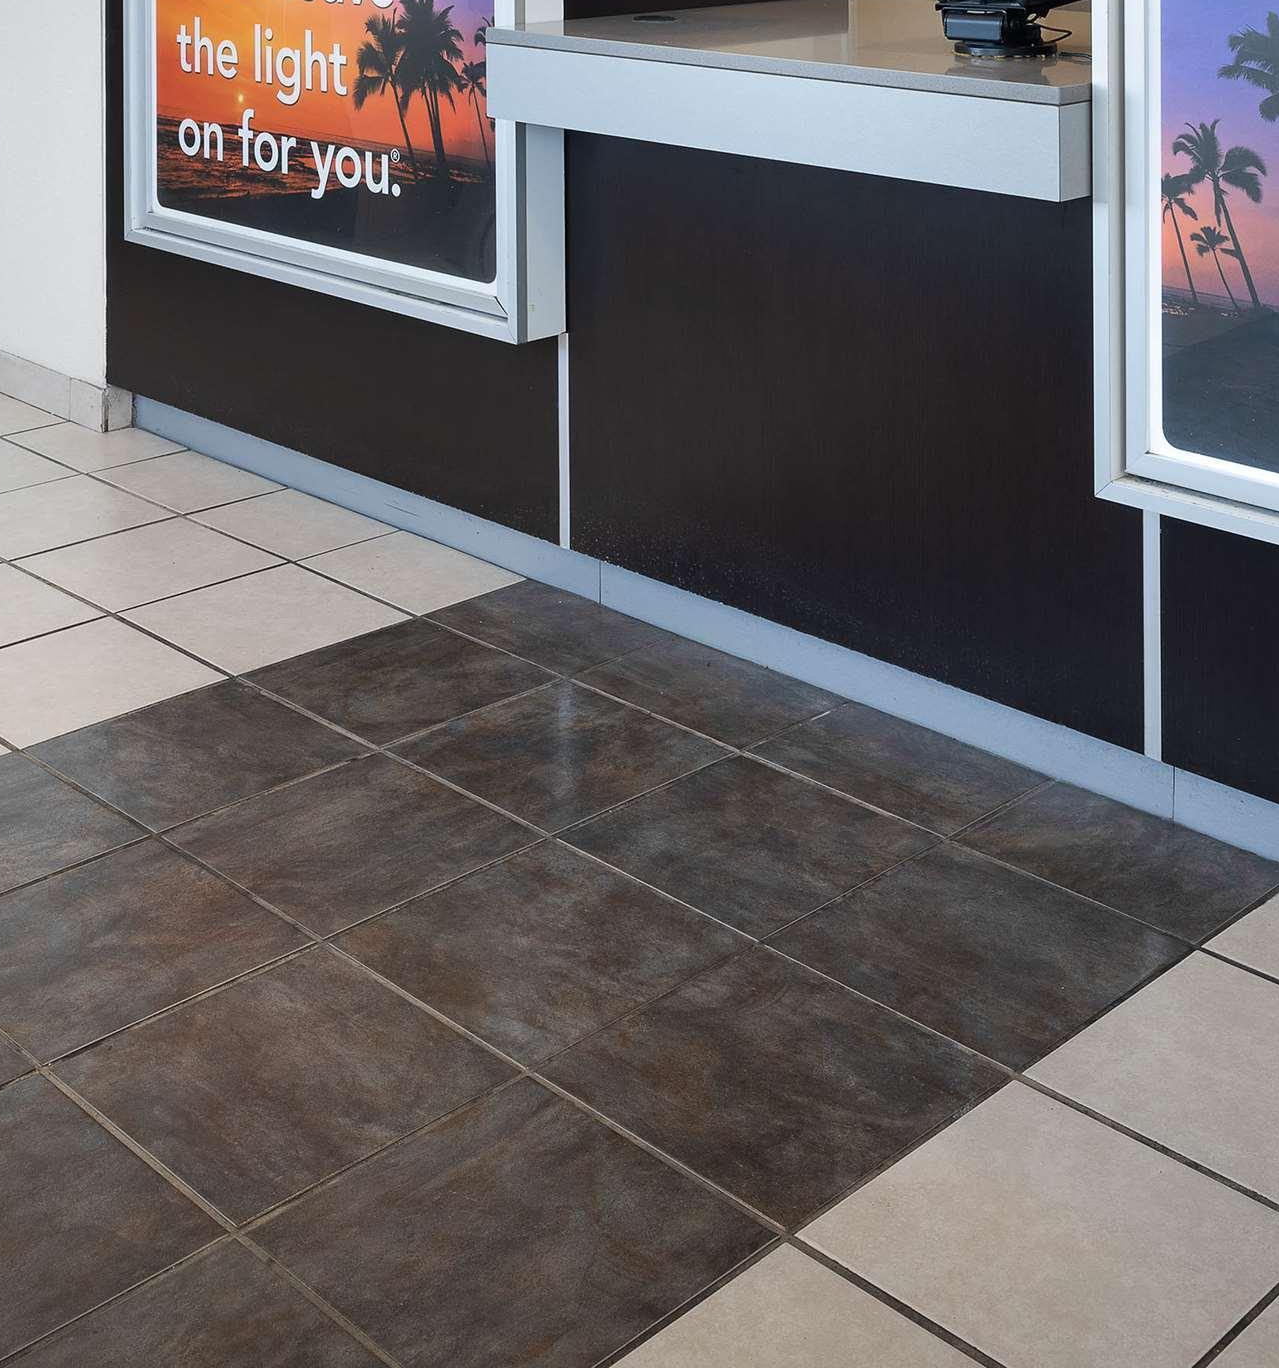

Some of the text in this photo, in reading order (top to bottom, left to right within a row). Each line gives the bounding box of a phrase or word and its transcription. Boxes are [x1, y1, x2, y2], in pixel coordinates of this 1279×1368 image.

[176, 16, 348, 106] the light
[178, 116, 224, 163] on
[238, 108, 296, 175] for
